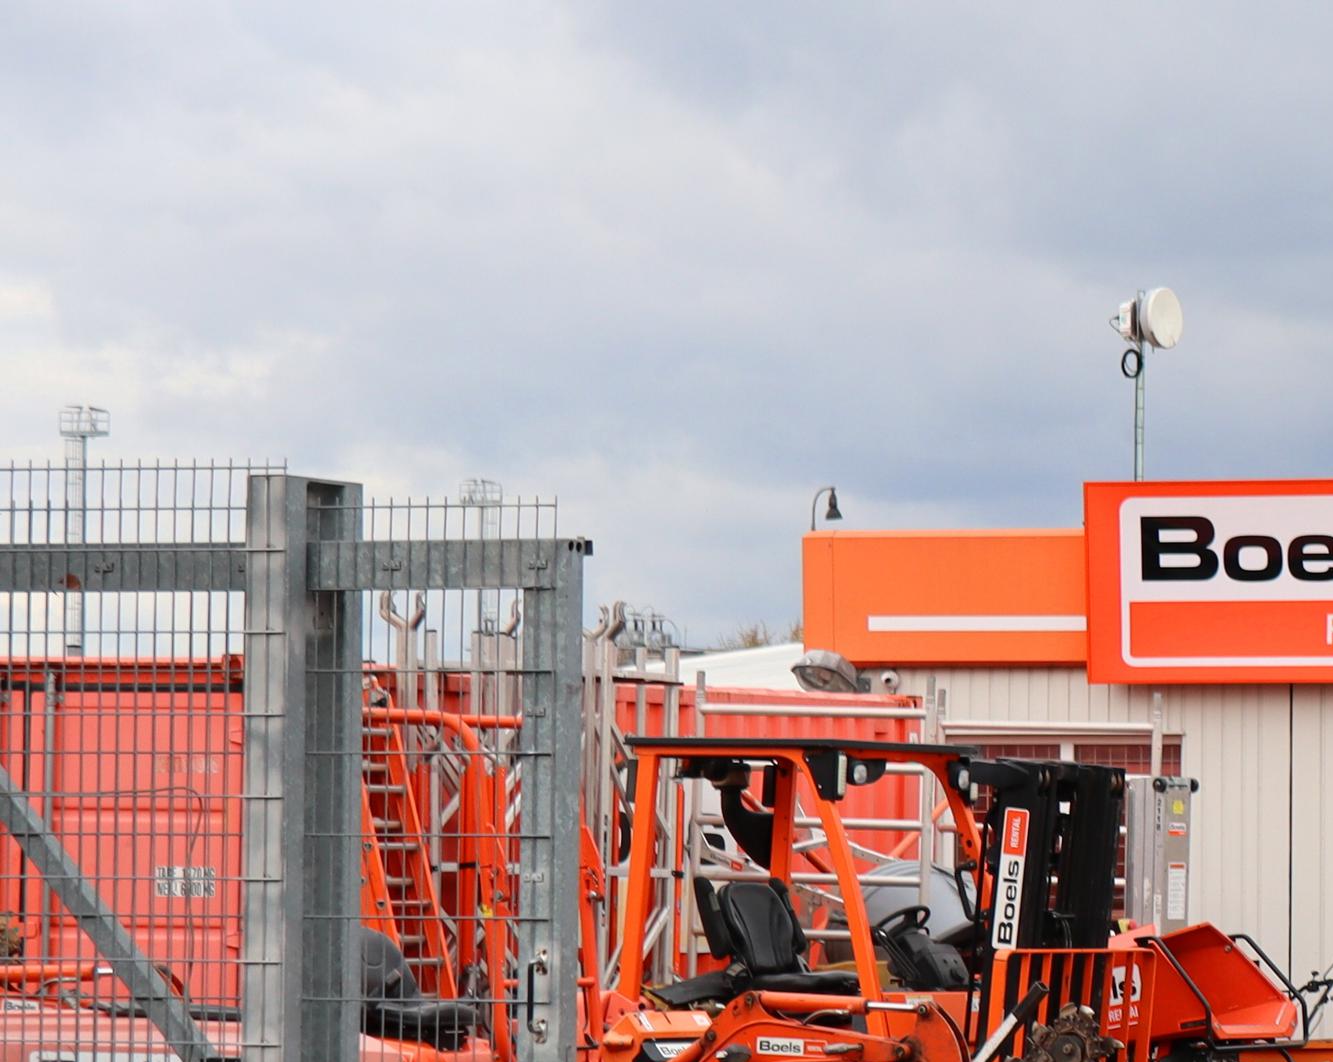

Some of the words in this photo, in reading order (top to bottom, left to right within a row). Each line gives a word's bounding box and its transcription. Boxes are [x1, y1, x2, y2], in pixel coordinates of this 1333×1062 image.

[1010, 816, 1022, 849] RENTAL
[997, 860, 1020, 945] Boels
[759, 1040, 801, 1053] Boels
